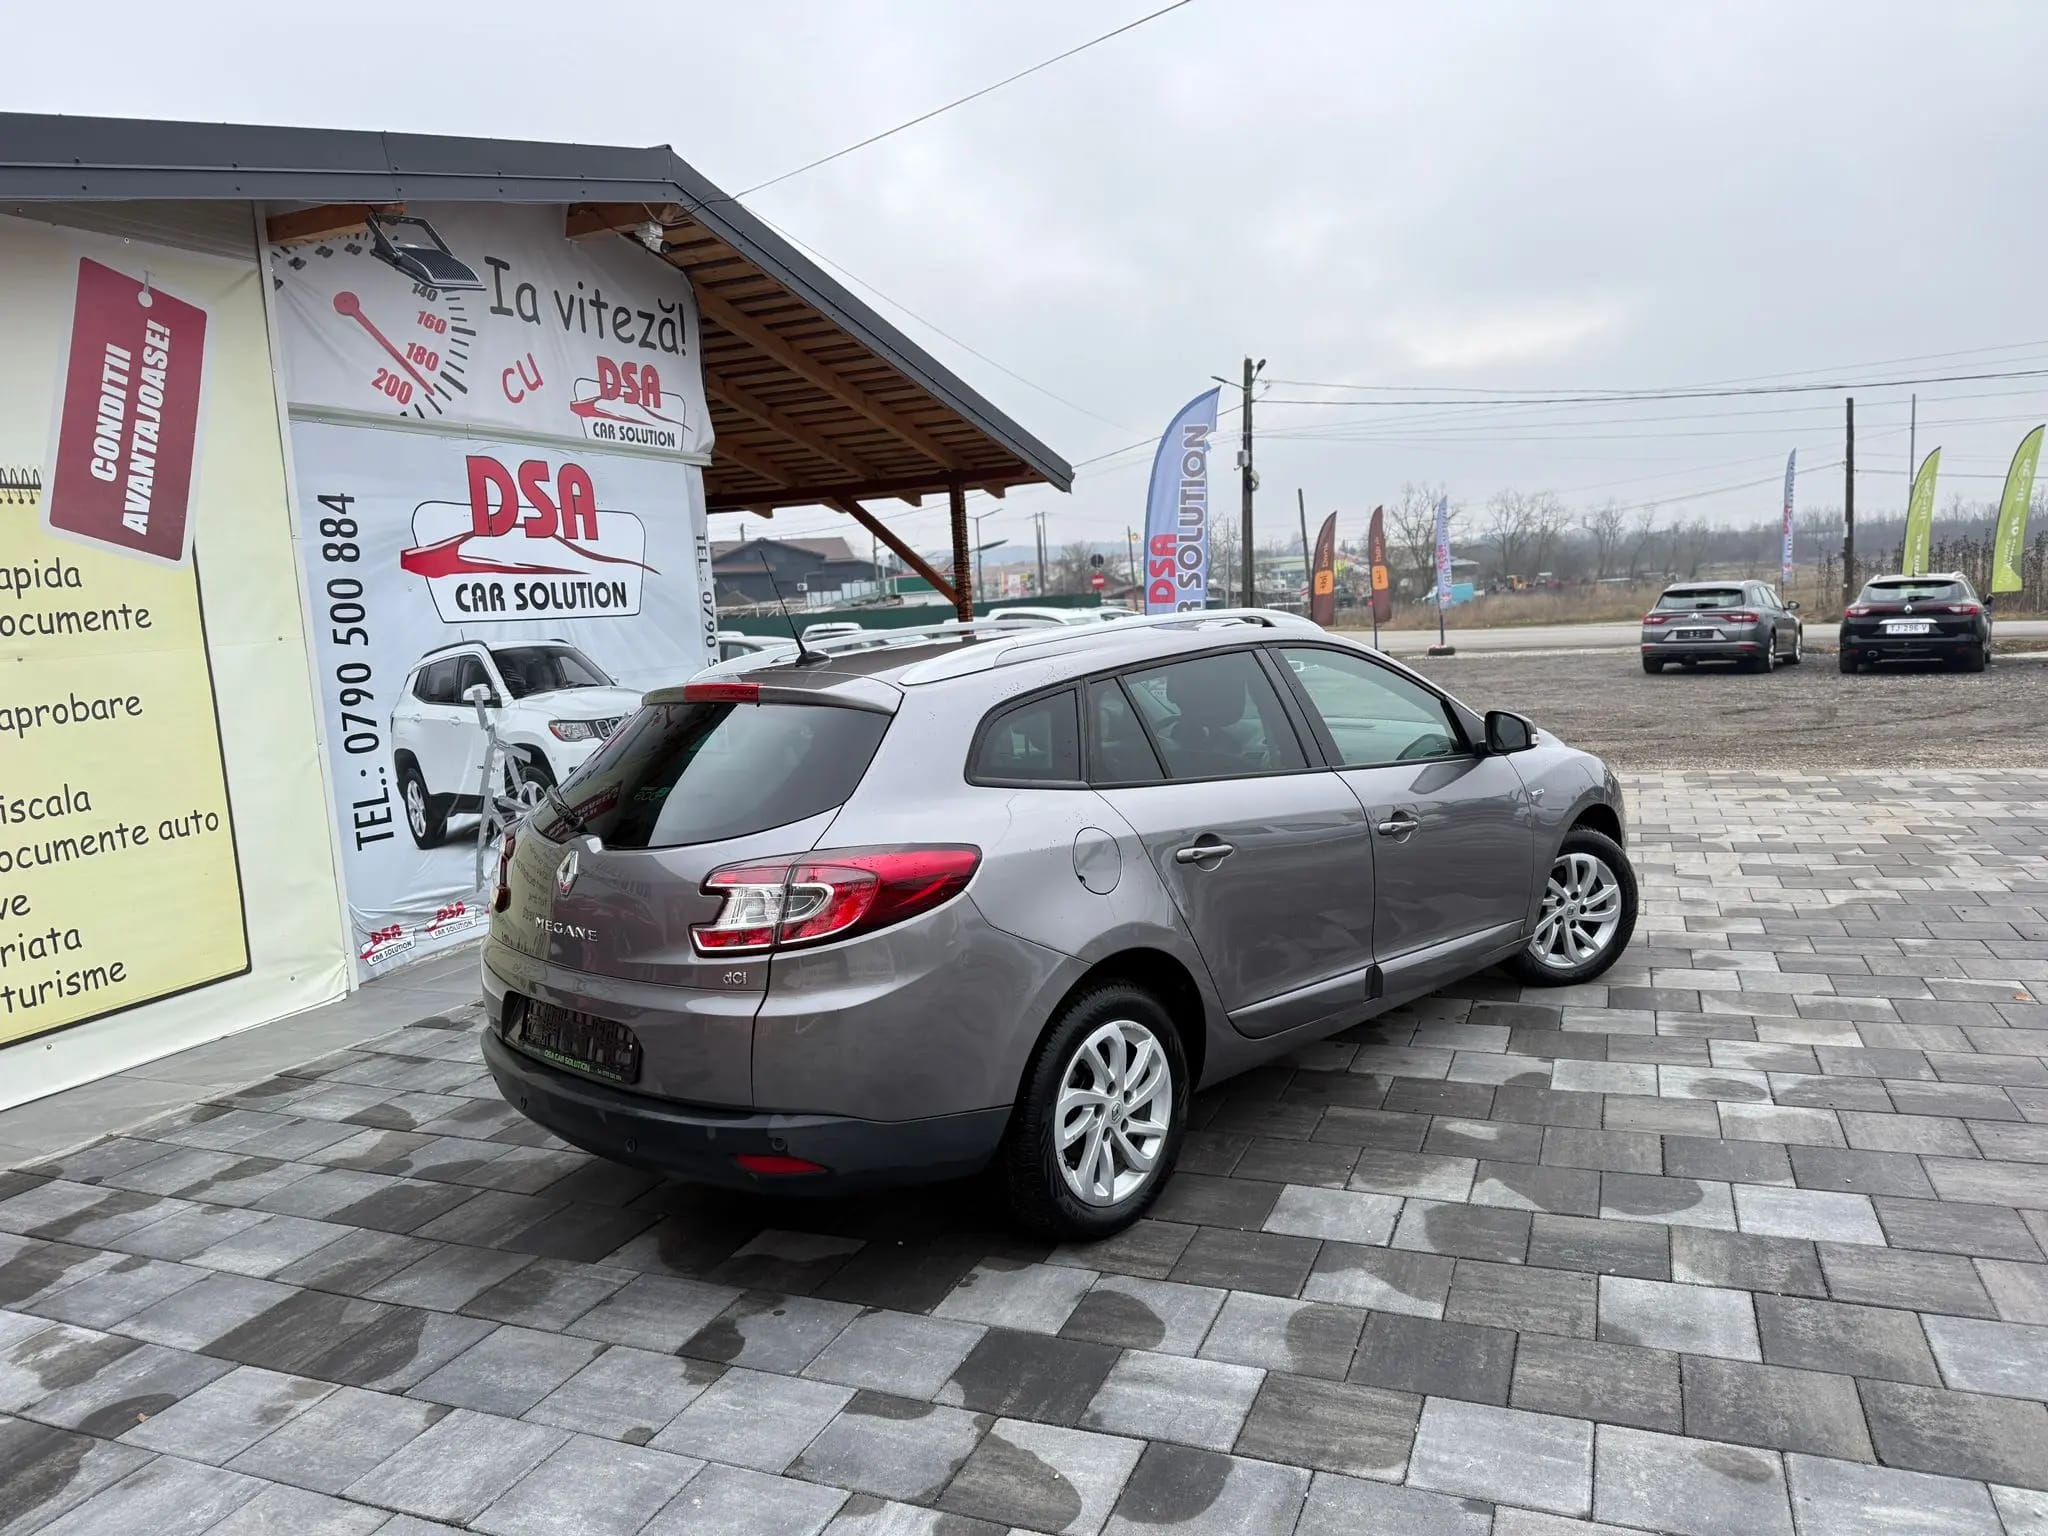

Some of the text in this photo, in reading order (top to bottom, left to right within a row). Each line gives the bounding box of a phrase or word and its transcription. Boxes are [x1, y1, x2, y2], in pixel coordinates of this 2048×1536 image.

[412, 283, 438, 302] 140
[416, 310, 447, 335] 160
[554, 281, 688, 356] viteză!
[406, 342, 440, 372] 180
[370, 367, 413, 405] 200
[597, 355, 661, 408] DSA
[90, 343, 131, 482] CONDITII
[122, 319, 171, 535] AVANTAJOASE!
[593, 421, 676, 447] CAR SOLUTION
[466, 455, 600, 540] DSA
[1176, 424, 1209, 589] SOLUTION
[0, 557, 82, 599] apida
[1150, 534, 1177, 604] DSA
[455, 581, 627, 612] CAR SOLUTION
[0, 603, 152, 637] ocumente
[702, 590, 717, 648] 0790
[317, 492, 393, 851] TEL.: 0790 500 884
[0, 693, 143, 738] aprobare
[0, 784, 91, 825] iscala
[0, 809, 219, 872] ocumente auto
[0, 925, 82, 967] riata
[446, 921, 474, 934] SOLUTION
[535, 917, 598, 942] MEGANE
[372, 941, 412, 963] CAR SOLUTION
[0, 959, 127, 1013] turisme
[565, 1057, 590, 1072] SOLUTION
